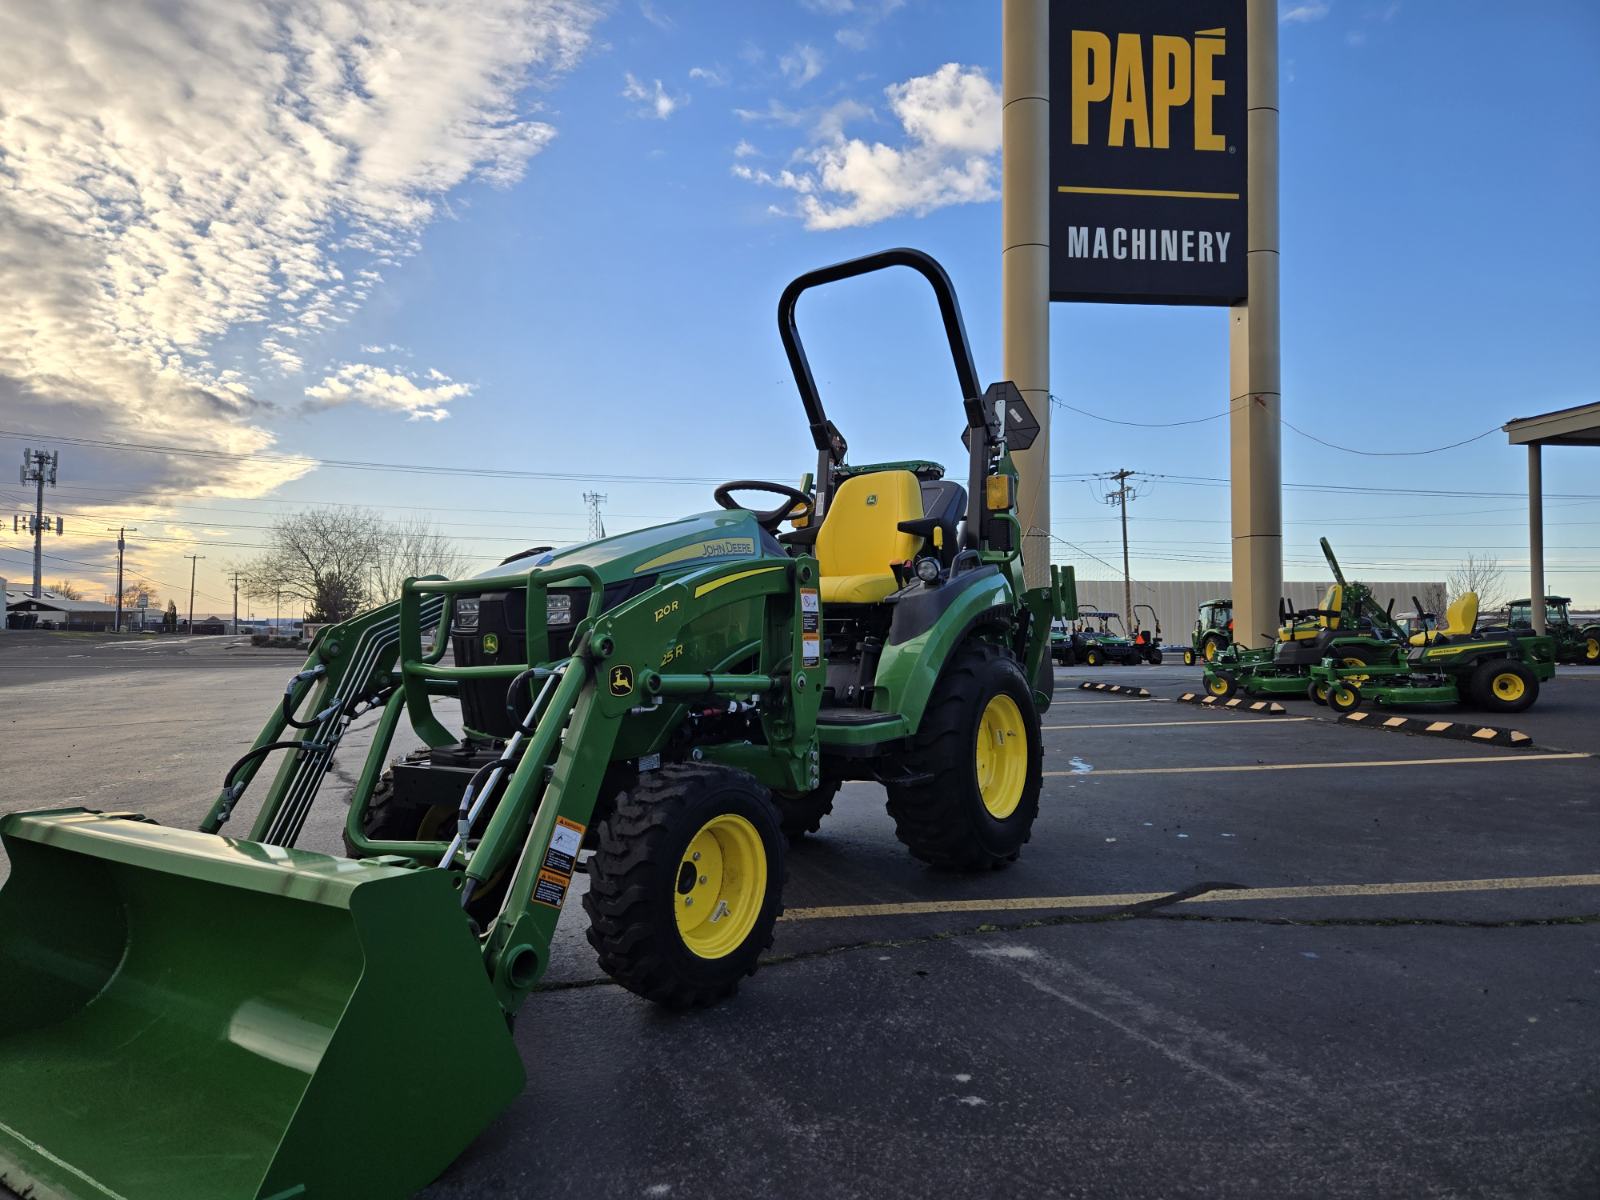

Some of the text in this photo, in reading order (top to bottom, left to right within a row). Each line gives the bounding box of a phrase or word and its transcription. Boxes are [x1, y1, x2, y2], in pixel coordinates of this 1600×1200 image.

[1071, 27, 1226, 152] PAPÉ
[1067, 225, 1231, 263] MACHINERY
[702, 541, 752, 557] JOHN DEERE
